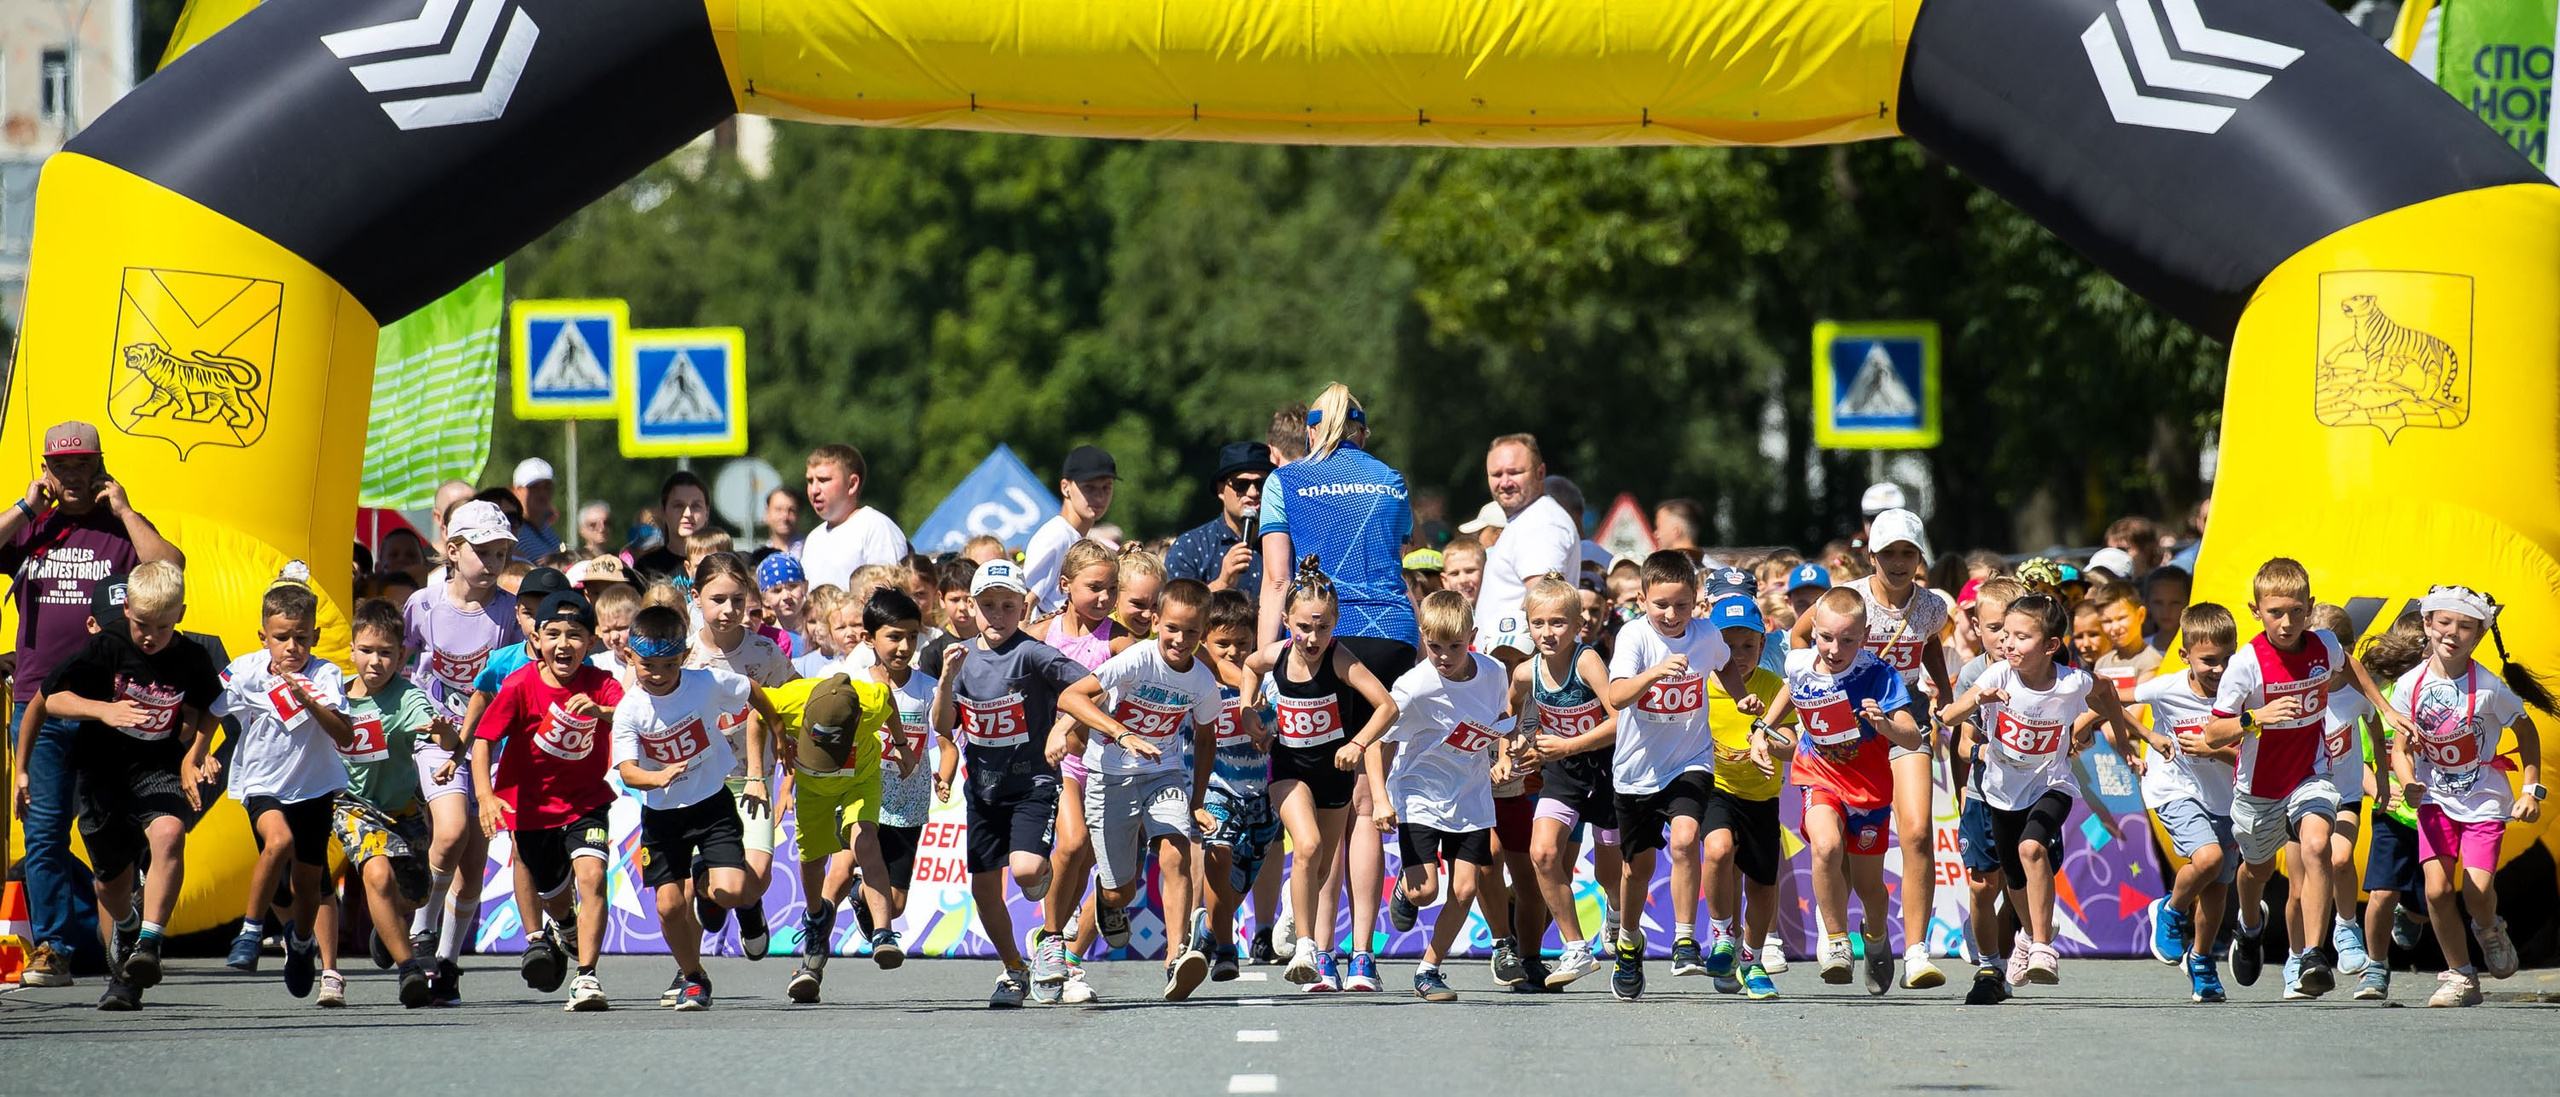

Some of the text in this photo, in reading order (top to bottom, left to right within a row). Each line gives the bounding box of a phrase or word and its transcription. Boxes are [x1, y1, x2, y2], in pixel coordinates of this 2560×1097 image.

[2473, 44, 2554, 80] СПО
[440, 657, 486, 681] 327
[1646, 684, 1698, 711] 206
[2273, 684, 2297, 692] ЗАБЕГ
[980, 696, 1016, 709] ПЕРВЫХ
[1132, 698, 1187, 712] ЗАБЕГ ПЕРВЫХ
[1298, 697, 1331, 707] ПЕРВЫХ
[1563, 701, 1595, 714] ПЕРВЫХ
[1808, 694, 1842, 708] ПЕРВЫХ
[664, 715, 695, 736] ПЕРВЫХ
[966, 710, 1016, 736] 375
[1122, 708, 1178, 735] 294
[1214, 712, 1236, 736] 5
[1281, 709, 1332, 735] 389
[1468, 720, 1491, 736] ЗАБЕГ
[1810, 711, 1830, 733] 4
[2027, 718, 2060, 727] ПЕРВЫХ
[2176, 716, 2199, 726] ЗАБЕГ
[544, 721, 595, 750] 306
[650, 730, 697, 761] 315
[830, 733, 842, 744] Z
[2002, 719, 2055, 752] 287
[2434, 729, 2467, 742] ПЕРВЫХ
[921, 823, 967, 848] БЕГ
[913, 856, 967, 884] ВЫХ
